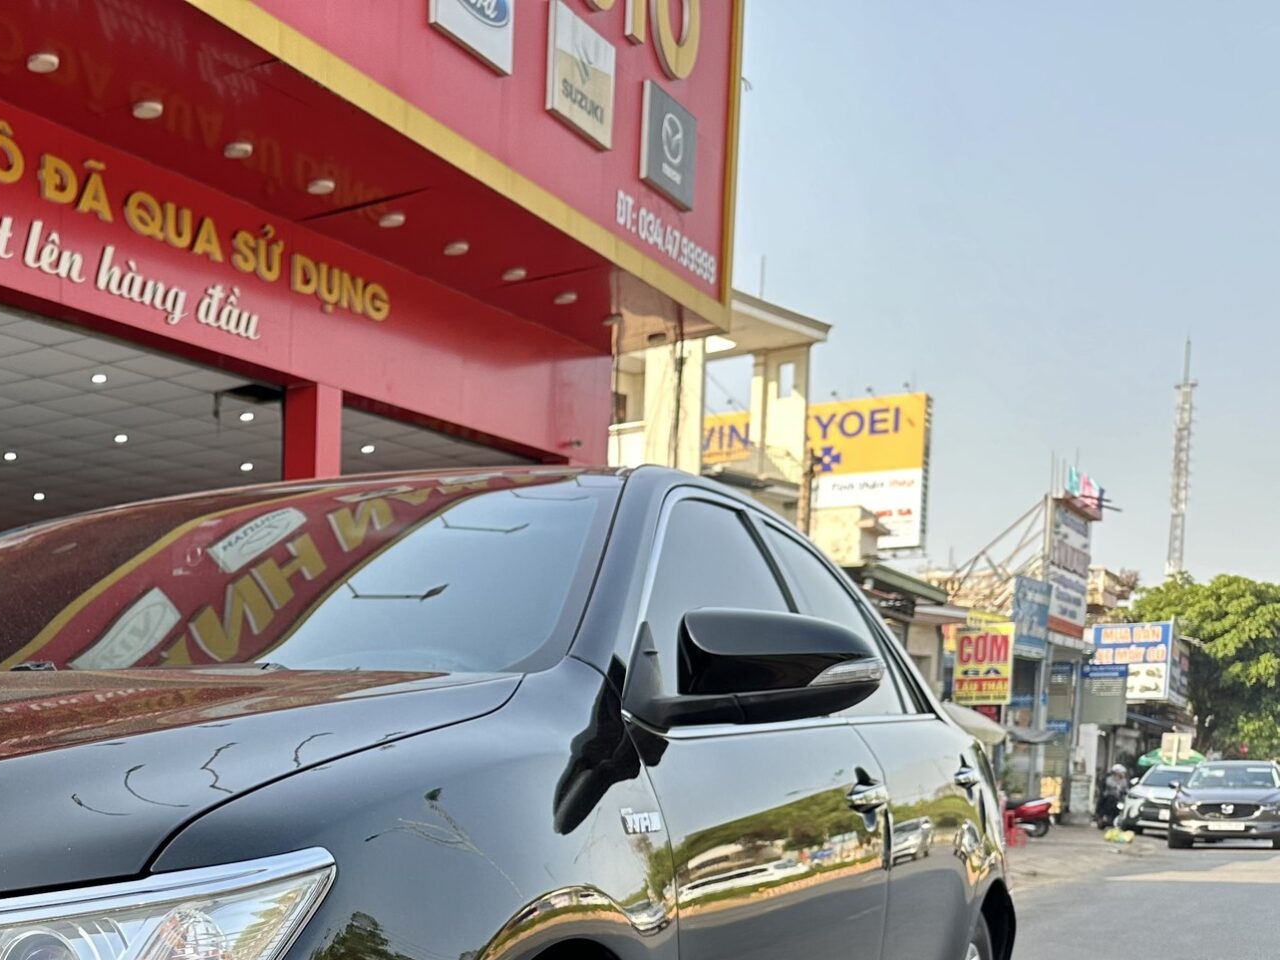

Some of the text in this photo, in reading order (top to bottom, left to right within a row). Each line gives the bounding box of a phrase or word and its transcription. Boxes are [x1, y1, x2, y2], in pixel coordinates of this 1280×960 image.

[561, 79, 605, 124] SUZUKI
[37, 152, 114, 223] ĐÃ
[124, 190, 225, 263] QUA
[231, 223, 284, 282] SỬ
[291, 252, 390, 323] DỤNG
[23, 219, 86, 283] lên
[95, 244, 189, 325] hàng
[196, 284, 261, 341] đầu
[807, 406, 900, 439] YOEI
[960, 632, 1009, 665] CƠM
